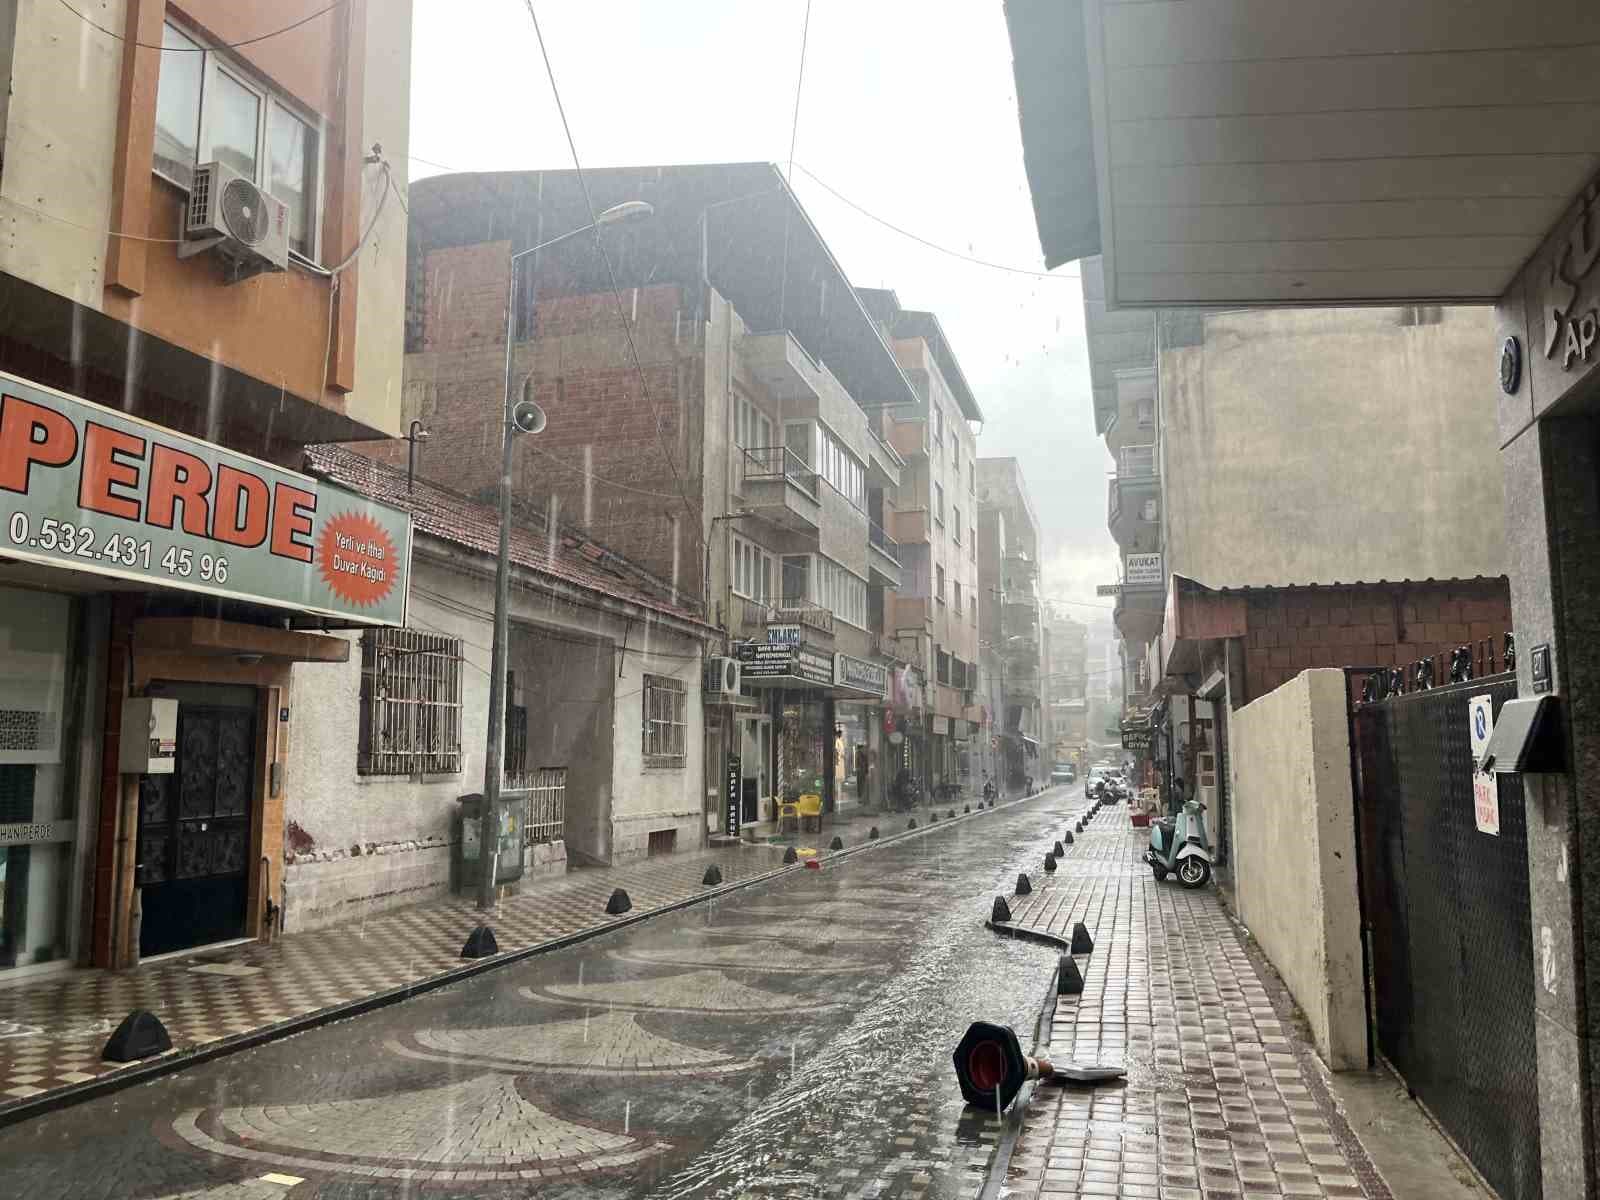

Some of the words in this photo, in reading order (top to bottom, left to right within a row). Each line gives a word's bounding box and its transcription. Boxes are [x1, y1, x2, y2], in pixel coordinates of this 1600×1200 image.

[0, 393, 317, 563] PERDE
[9, 511, 152, 569] 0.532.431
[161, 546, 193, 577] 45
[200, 554, 229, 584] 96
[335, 531, 354, 551] Yerli
[356, 541, 366, 554] ve
[333, 553, 359, 574] Duvar
[1128, 556, 1159, 568] AVUKAT
